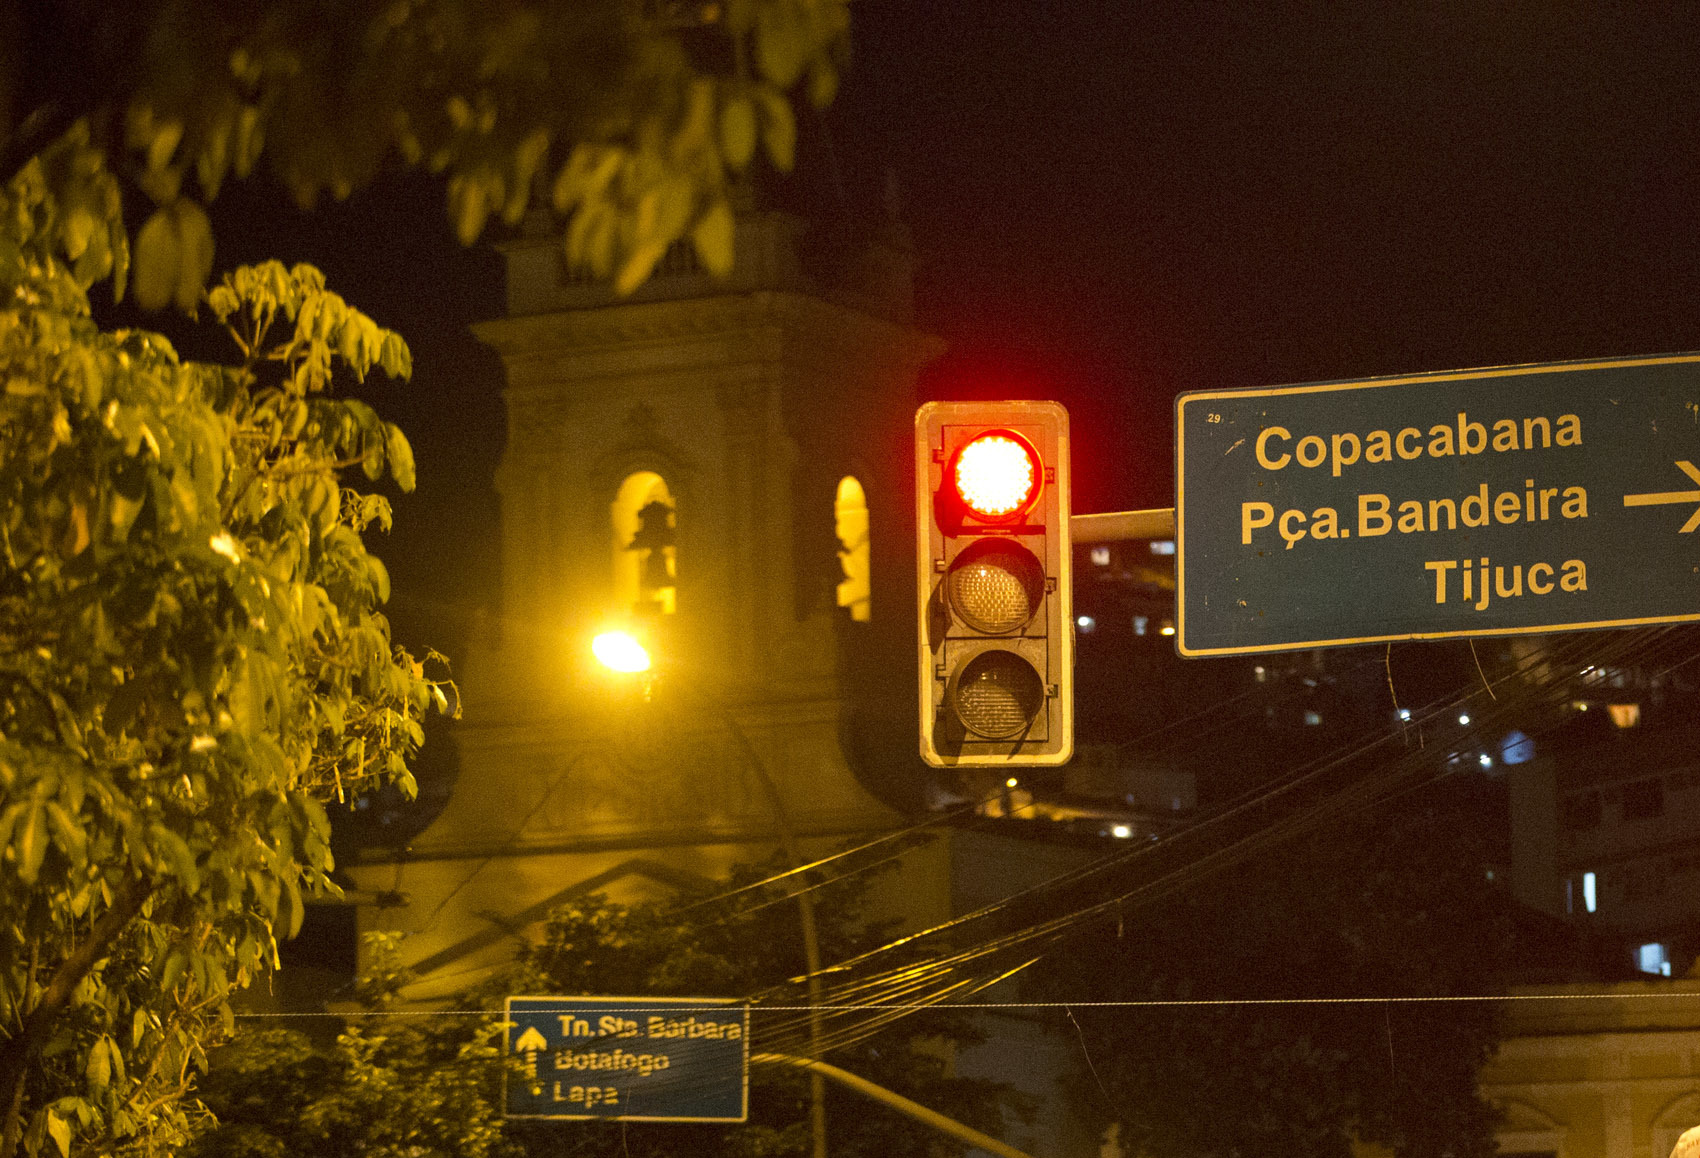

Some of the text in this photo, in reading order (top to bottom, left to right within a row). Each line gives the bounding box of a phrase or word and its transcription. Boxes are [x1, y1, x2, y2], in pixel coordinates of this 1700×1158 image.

[1207, 412, 1221, 424] 29
[1254, 411, 1583, 478] Copacabana
[1424, 557, 1589, 611] Tijuca
[554, 1049, 670, 1077] Botafogo
[553, 1081, 619, 1109] Lapa
